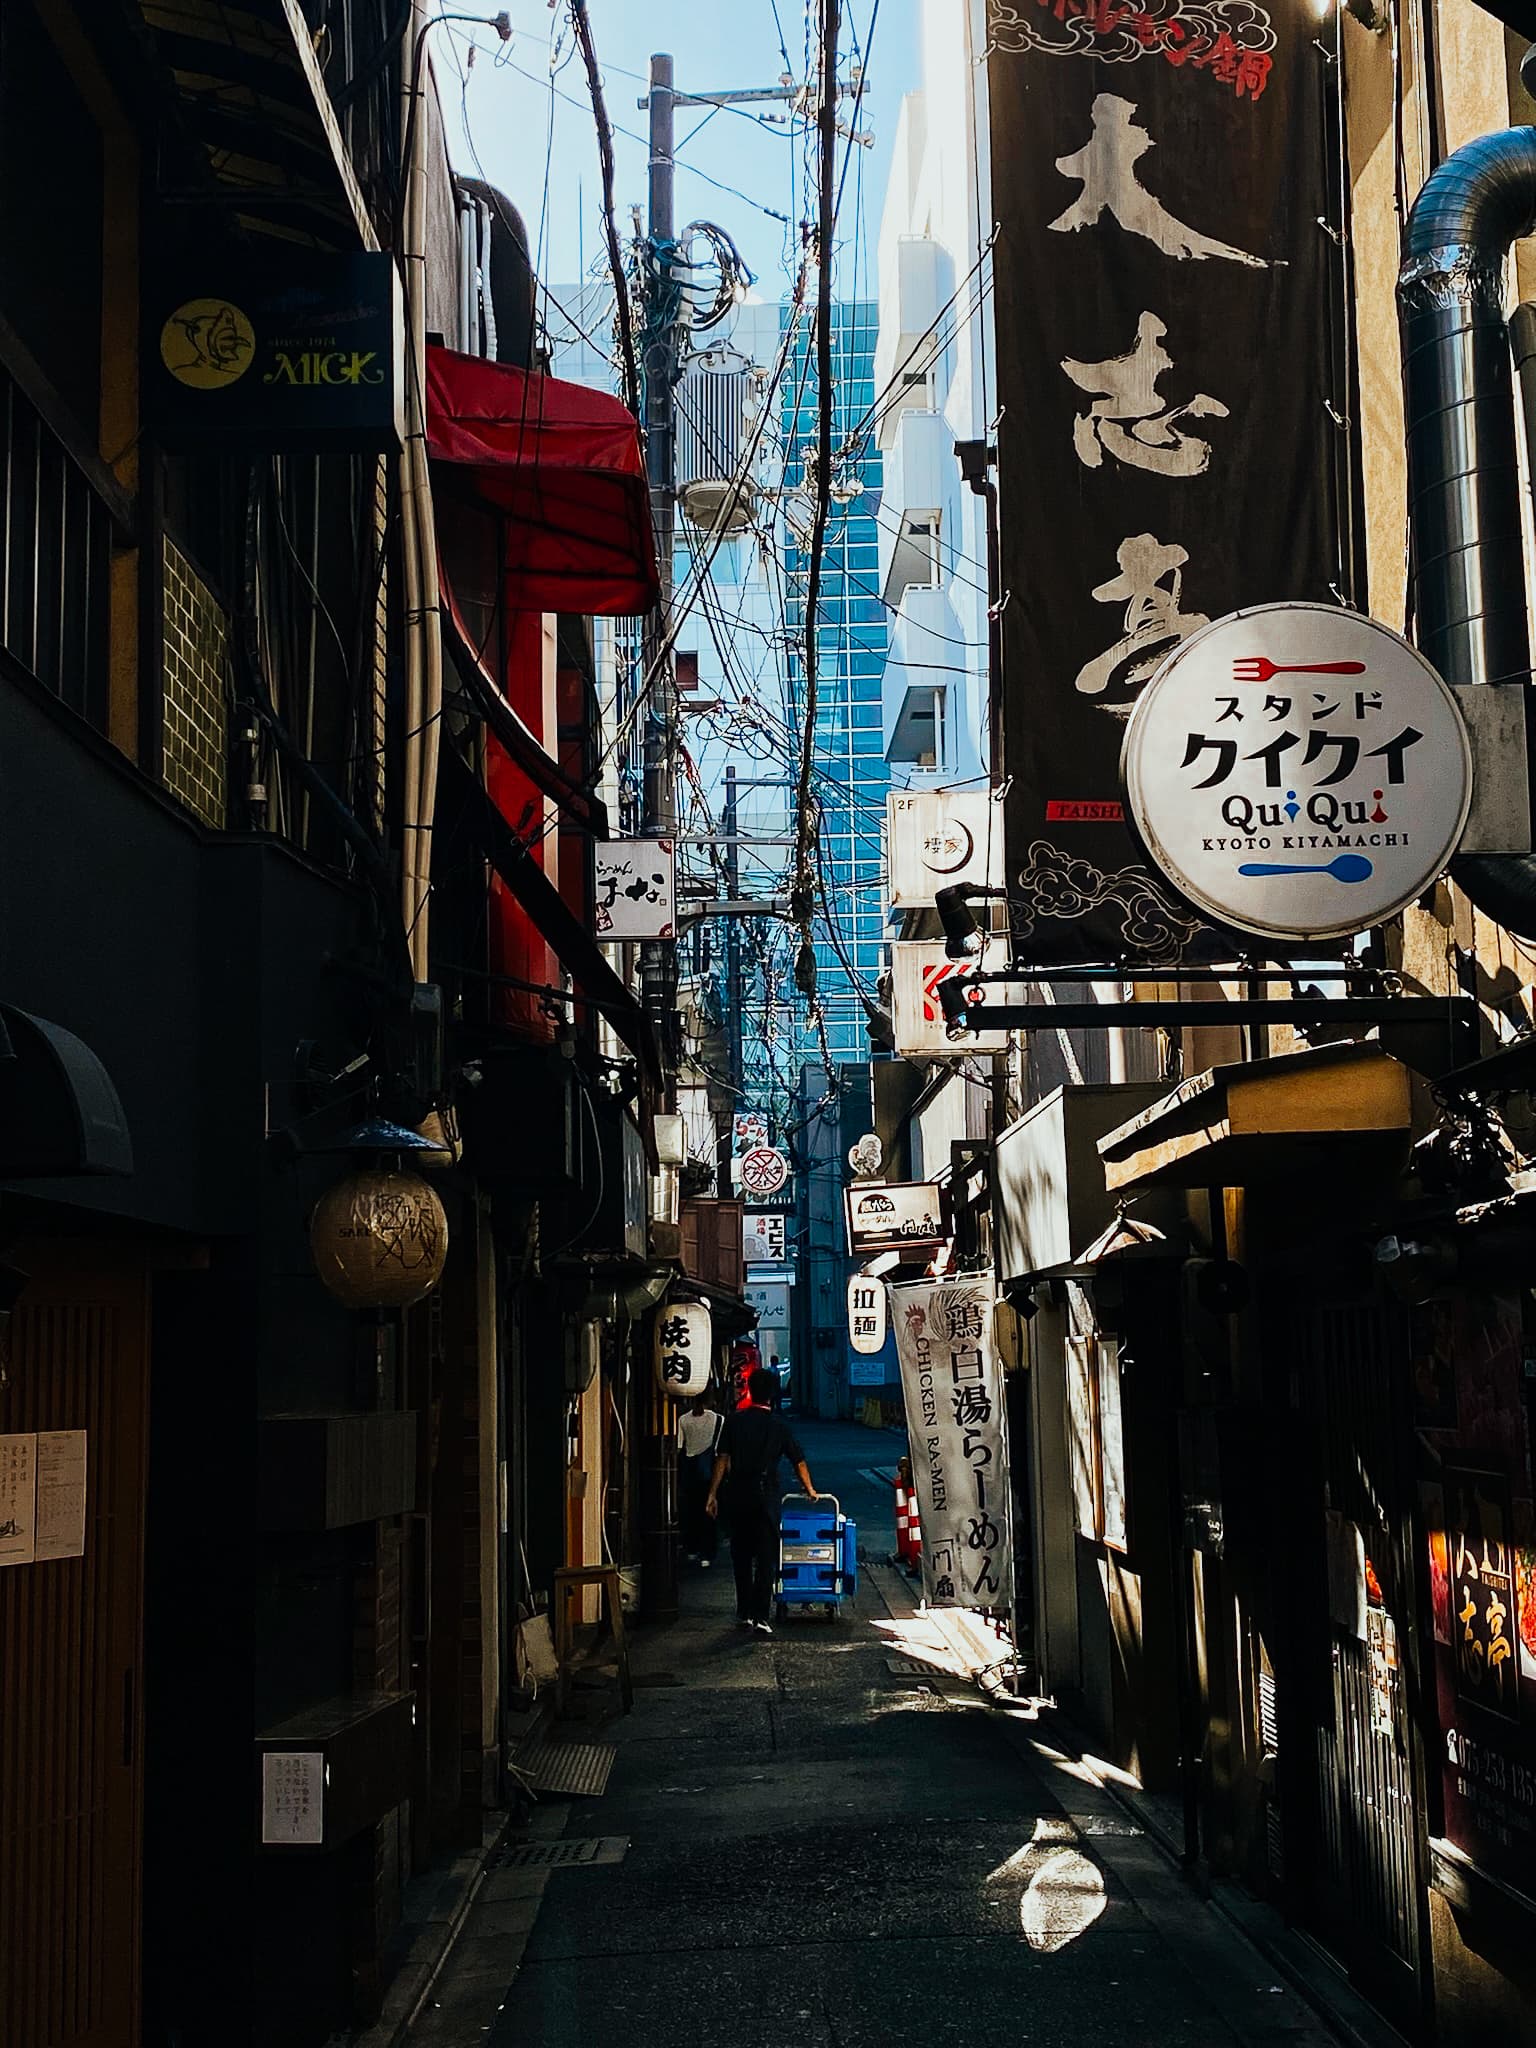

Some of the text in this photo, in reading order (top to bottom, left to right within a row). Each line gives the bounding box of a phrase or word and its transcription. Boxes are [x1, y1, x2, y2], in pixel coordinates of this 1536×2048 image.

[263, 351, 385, 386] MICK
[1215, 692, 1383, 723] スタンド
[1180, 726, 1424, 789] クイクイ
[896, 799, 914, 811] 2F
[1202, 833, 1410, 851] KYOTO KIYAMACHI
[768, 1218, 783, 1258] エビス
[660, 1316, 690, 1384] 焼肉
[915, 1337, 947, 1513] CHICKEN RA-MEN
[944, 1302, 1001, 1597] 鶏白湯らーめん
